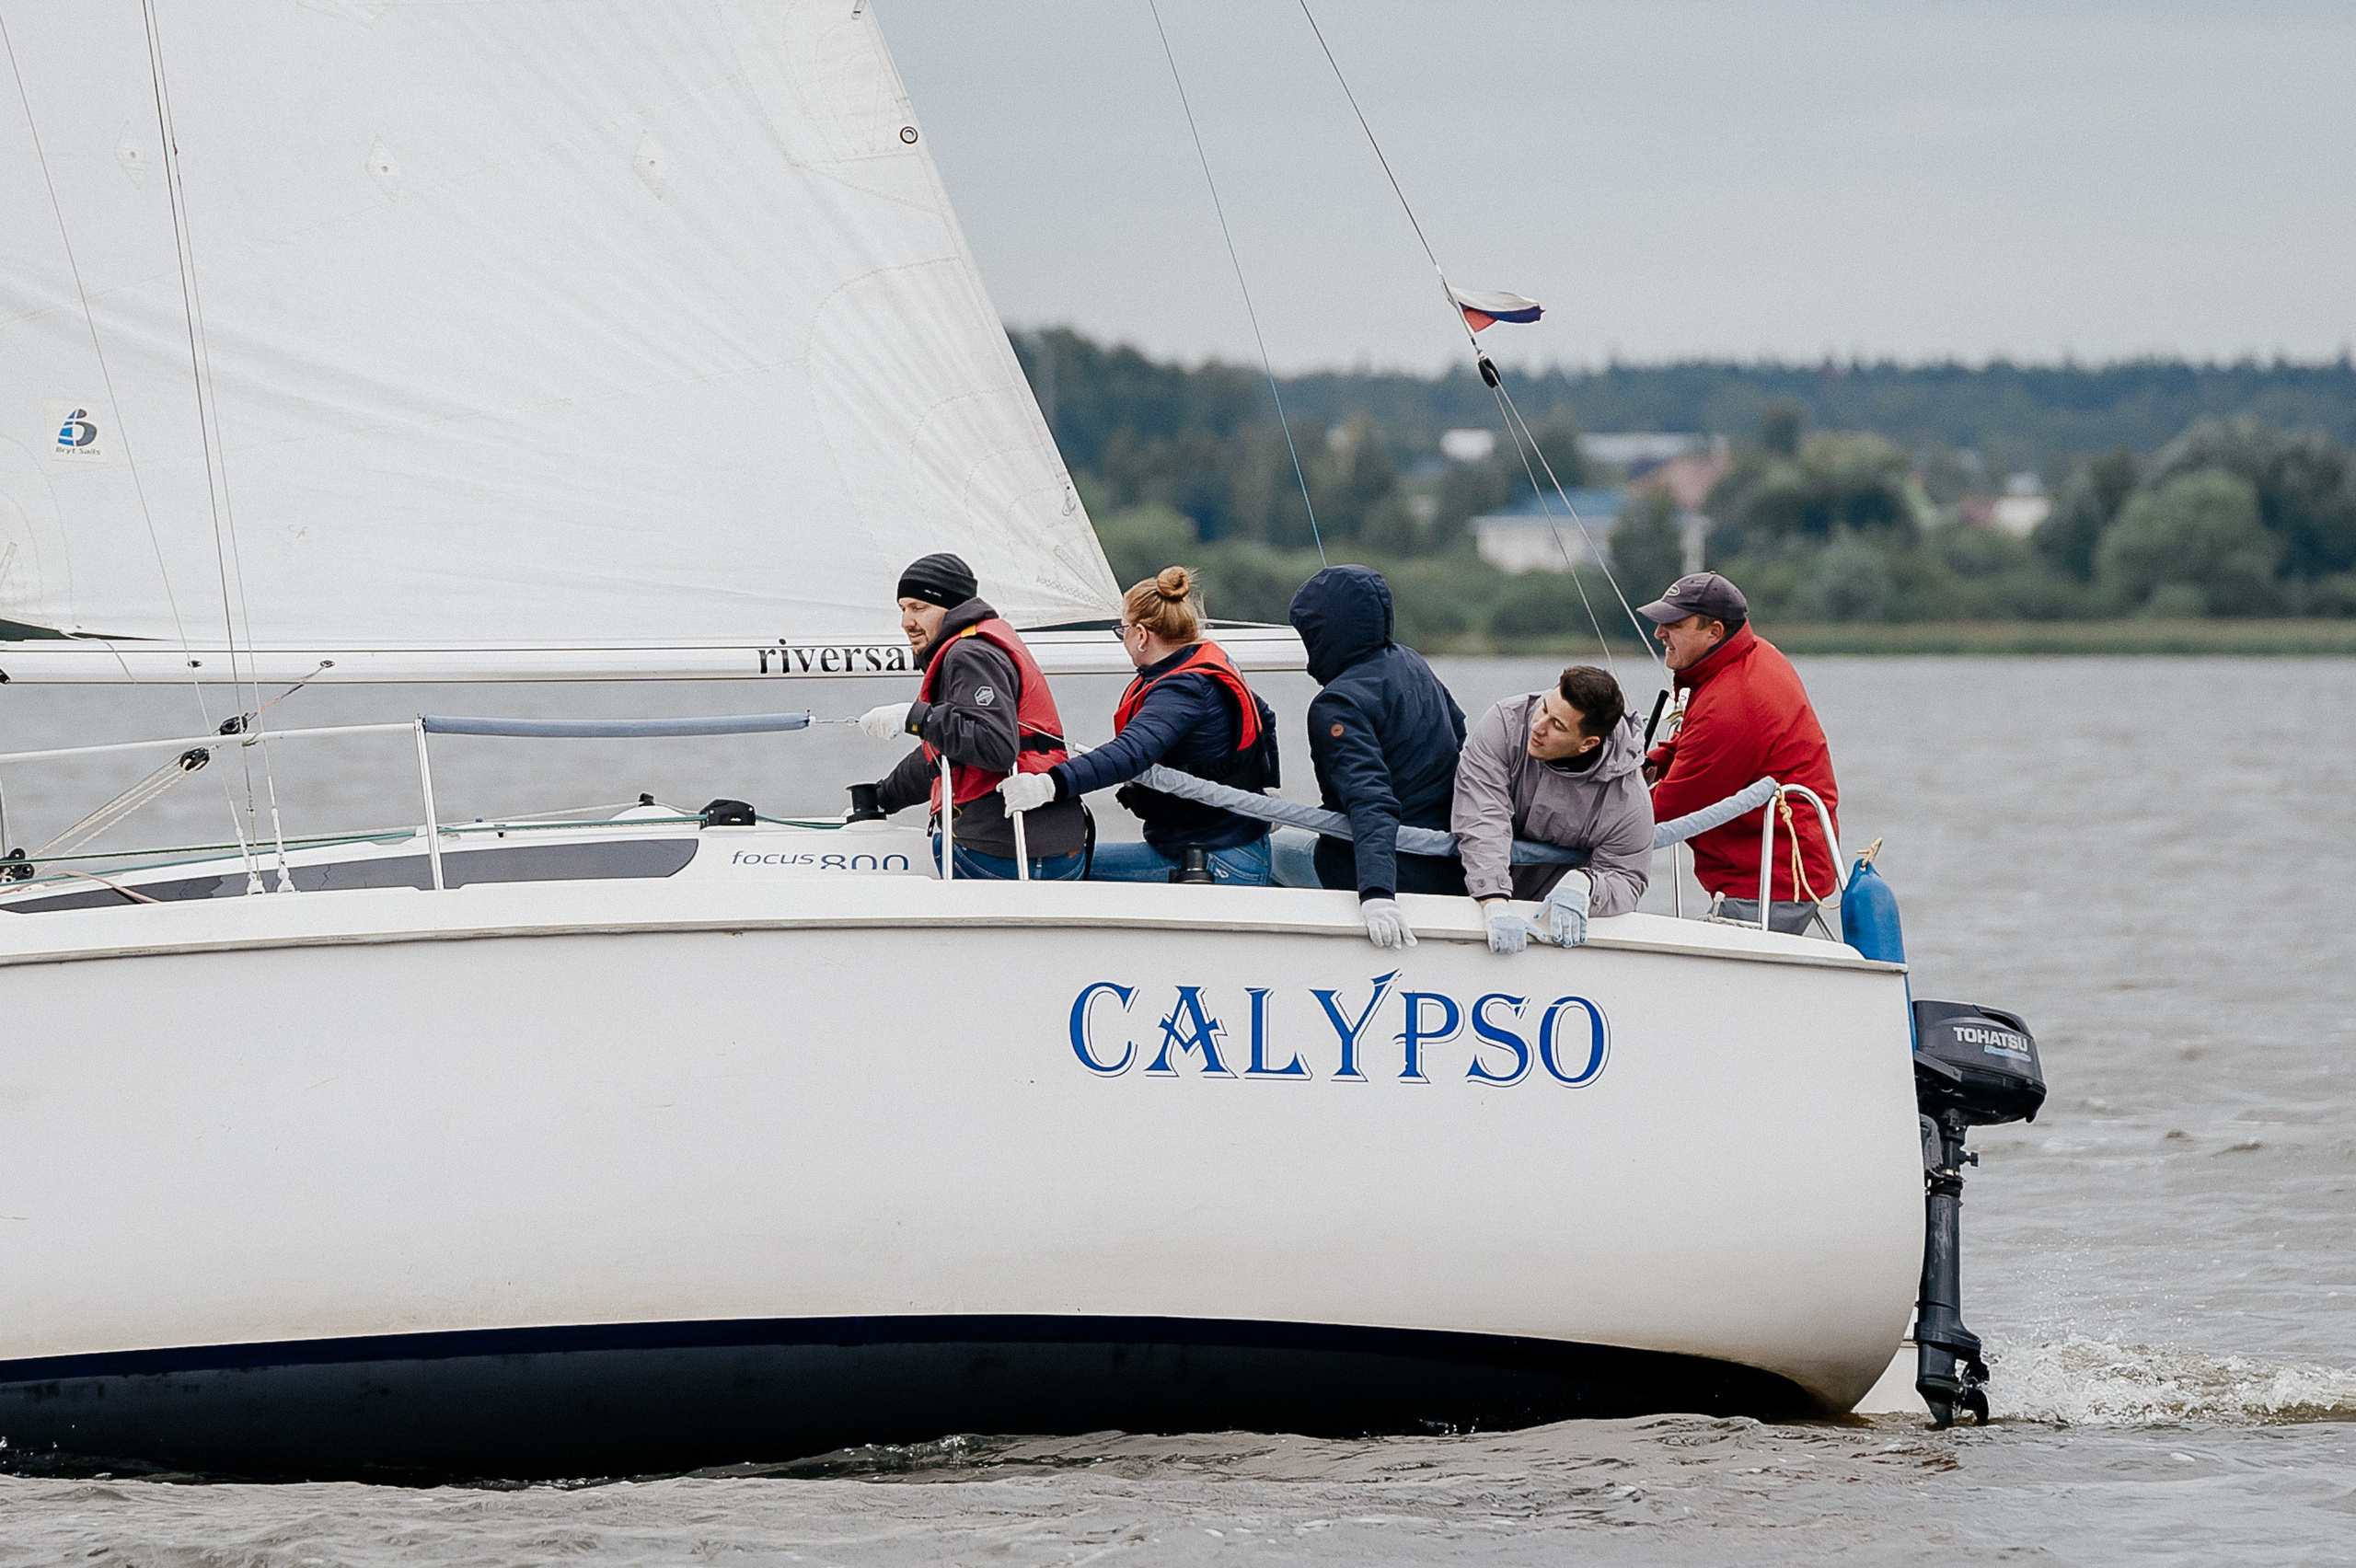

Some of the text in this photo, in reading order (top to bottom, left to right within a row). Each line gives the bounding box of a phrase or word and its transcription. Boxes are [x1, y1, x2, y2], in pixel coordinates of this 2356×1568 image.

[732, 850, 815, 865] focus
[1069, 968, 1611, 1089] CALYPSO
[1953, 1026, 2028, 1052] TOHATSU
